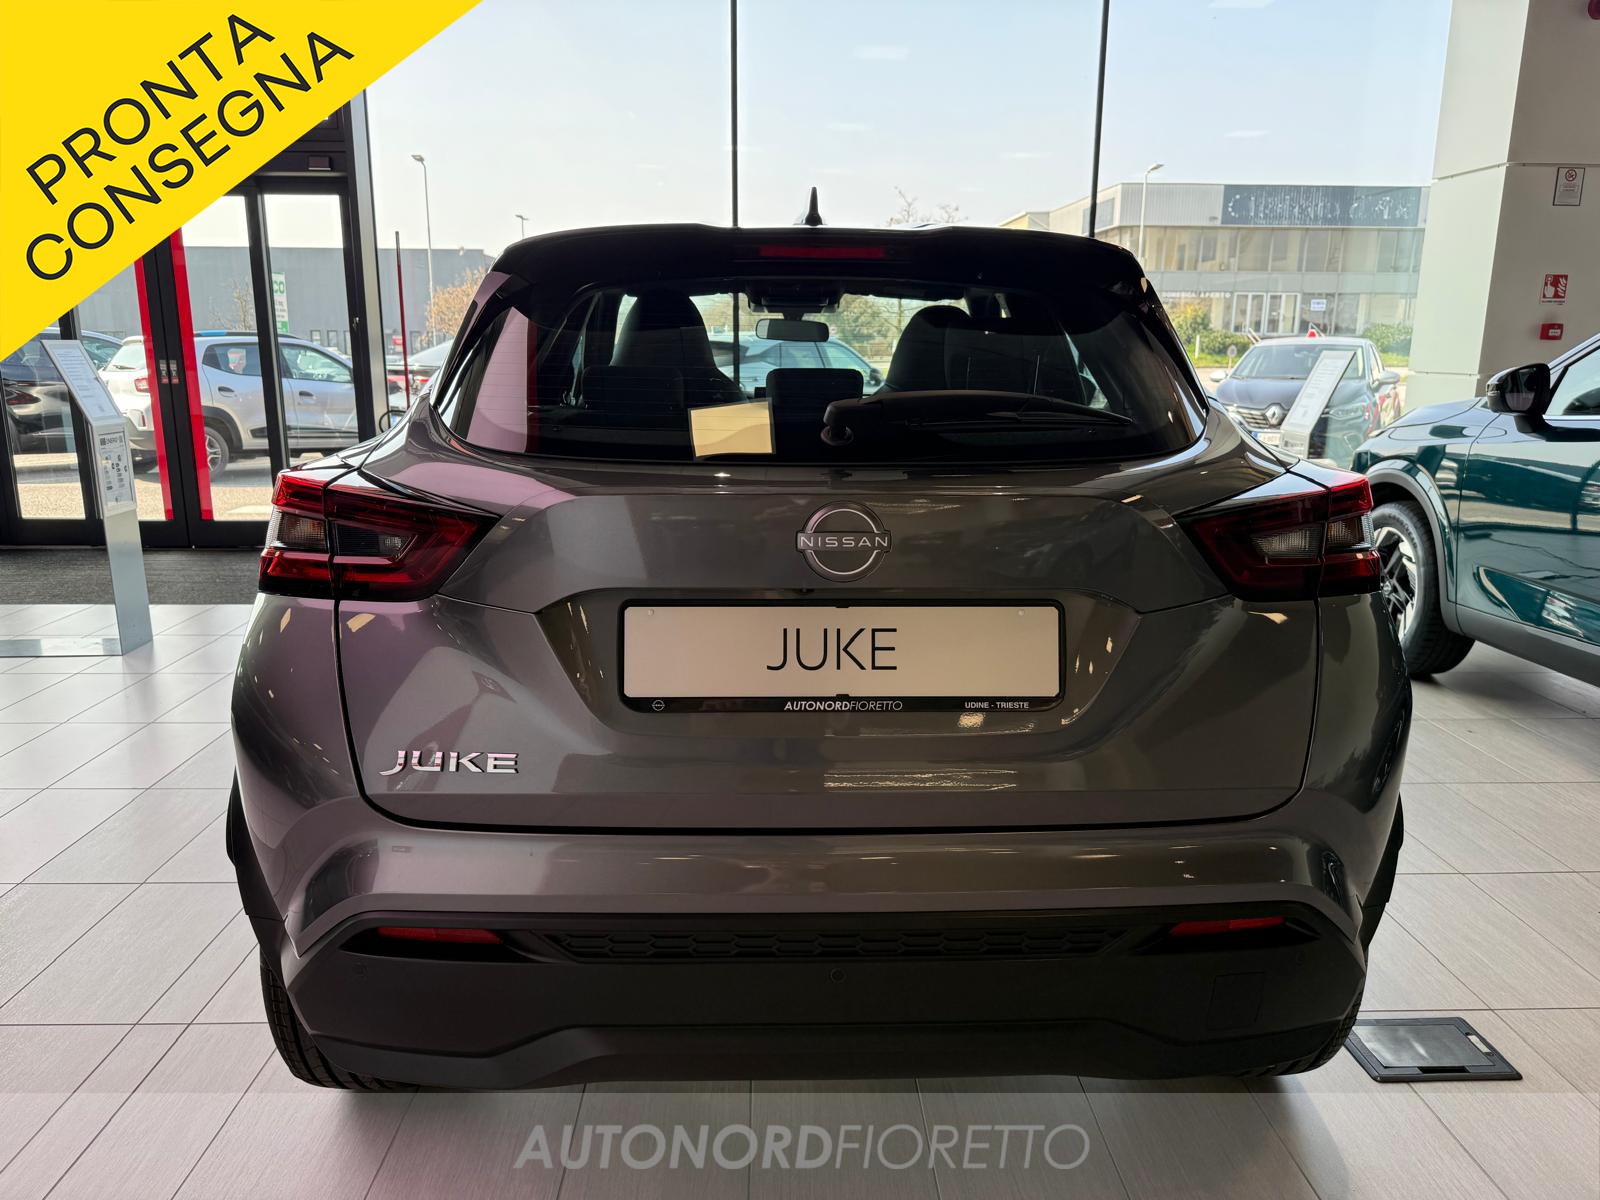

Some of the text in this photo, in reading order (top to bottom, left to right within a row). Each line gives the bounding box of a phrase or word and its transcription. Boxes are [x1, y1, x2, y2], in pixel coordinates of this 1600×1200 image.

[800, 536, 888, 548] NISSAN
[767, 628, 897, 671] JUKE
[784, 701, 903, 711] AUTONORDFIORETTO
[964, 701, 990, 709] UDINE
[995, 701, 1030, 709] TRIESTE
[379, 750, 519, 776] JUKE
